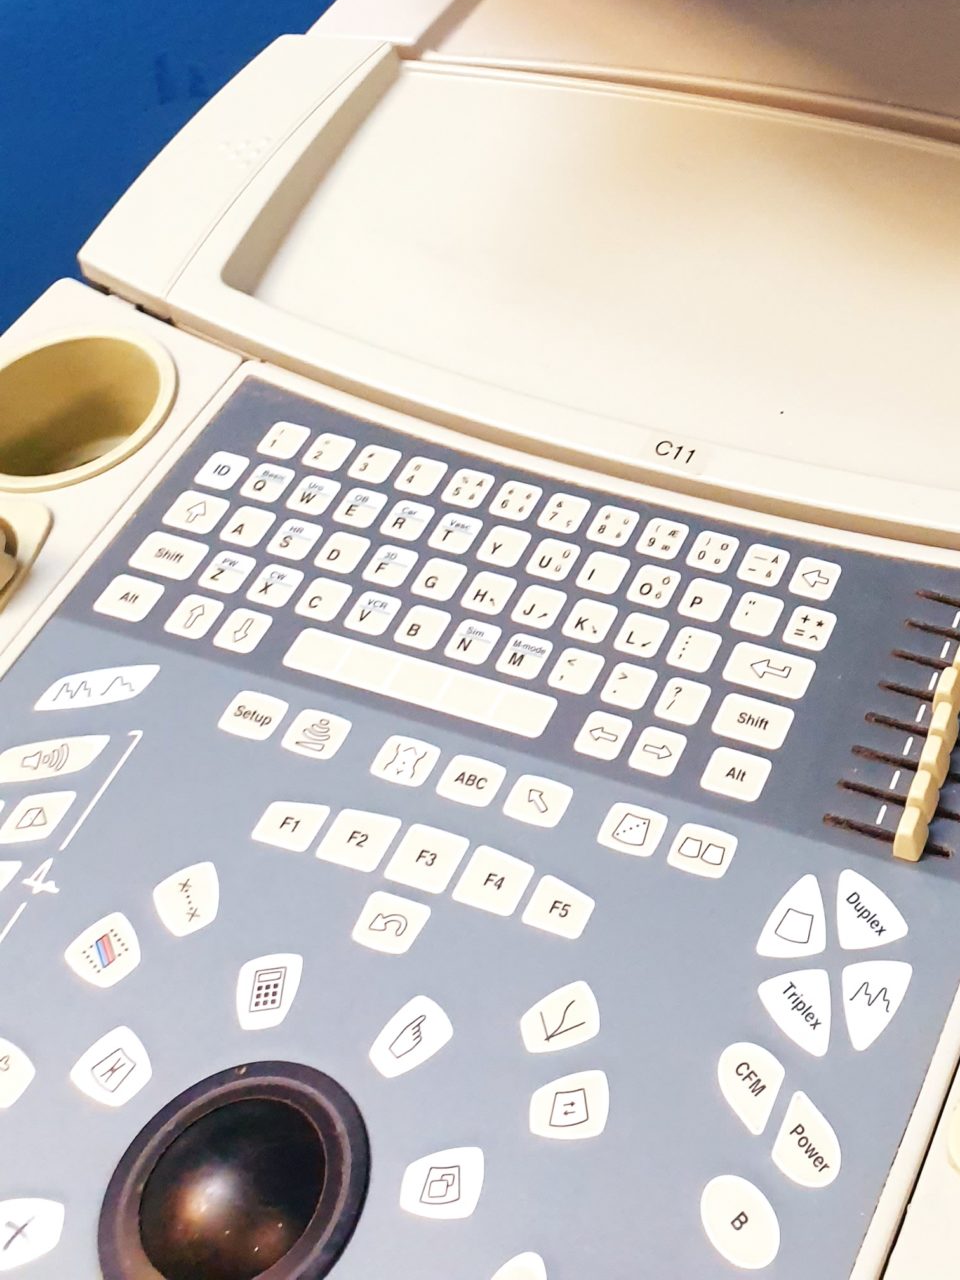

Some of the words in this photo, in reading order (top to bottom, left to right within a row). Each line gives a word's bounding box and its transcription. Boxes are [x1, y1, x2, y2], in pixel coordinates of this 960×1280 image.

[655, 440, 696, 464] C11
[212, 464, 231, 476] ID
[253, 479, 267, 492] Q
[452, 486, 463, 496] 5
[299, 491, 317, 504] W
[500, 499, 510, 509] 6
[344, 504, 360, 517] E
[231, 523, 245, 536] A
[391, 517, 406, 529] R
[597, 524, 607, 535] 8
[279, 535, 293, 548] S
[441, 529, 453, 542] T
[647, 537, 656, 548] 9
[153, 547, 185, 564] Shift
[326, 549, 341, 561] D
[490, 542, 503, 555] Y
[374, 562, 389, 574] F
[538, 555, 553, 569] U
[209, 567, 226, 581] Z
[258, 581, 273, 595] X
[424, 576, 439, 589] G
[639, 582, 653, 596] O
[119, 591, 140, 604] Alt
[308, 595, 323, 609] C
[472, 588, 489, 603] H
[689, 596, 703, 609] P
[359, 609, 372, 622] V
[522, 603, 536, 616] J
[406, 624, 421, 637] B
[574, 616, 589, 631] K
[456, 637, 472, 652] N
[625, 631, 636, 645] L
[507, 652, 525, 667] M
[233, 704, 272, 727] Setup
[737, 712, 769, 731] Shift
[454, 771, 488, 790] ABC
[725, 767, 746, 782] Alt
[279, 816, 301, 833] F1
[346, 830, 369, 848] F2
[415, 849, 438, 867] F3
[483, 873, 505, 891] F4
[549, 900, 572, 918] F5
[845, 891, 887, 937] Duplex
[782, 981, 822, 1031] Triplex
[734, 1061, 767, 1098] CFM
[789, 1123, 830, 1173] Power
[730, 1211, 749, 1231] B
